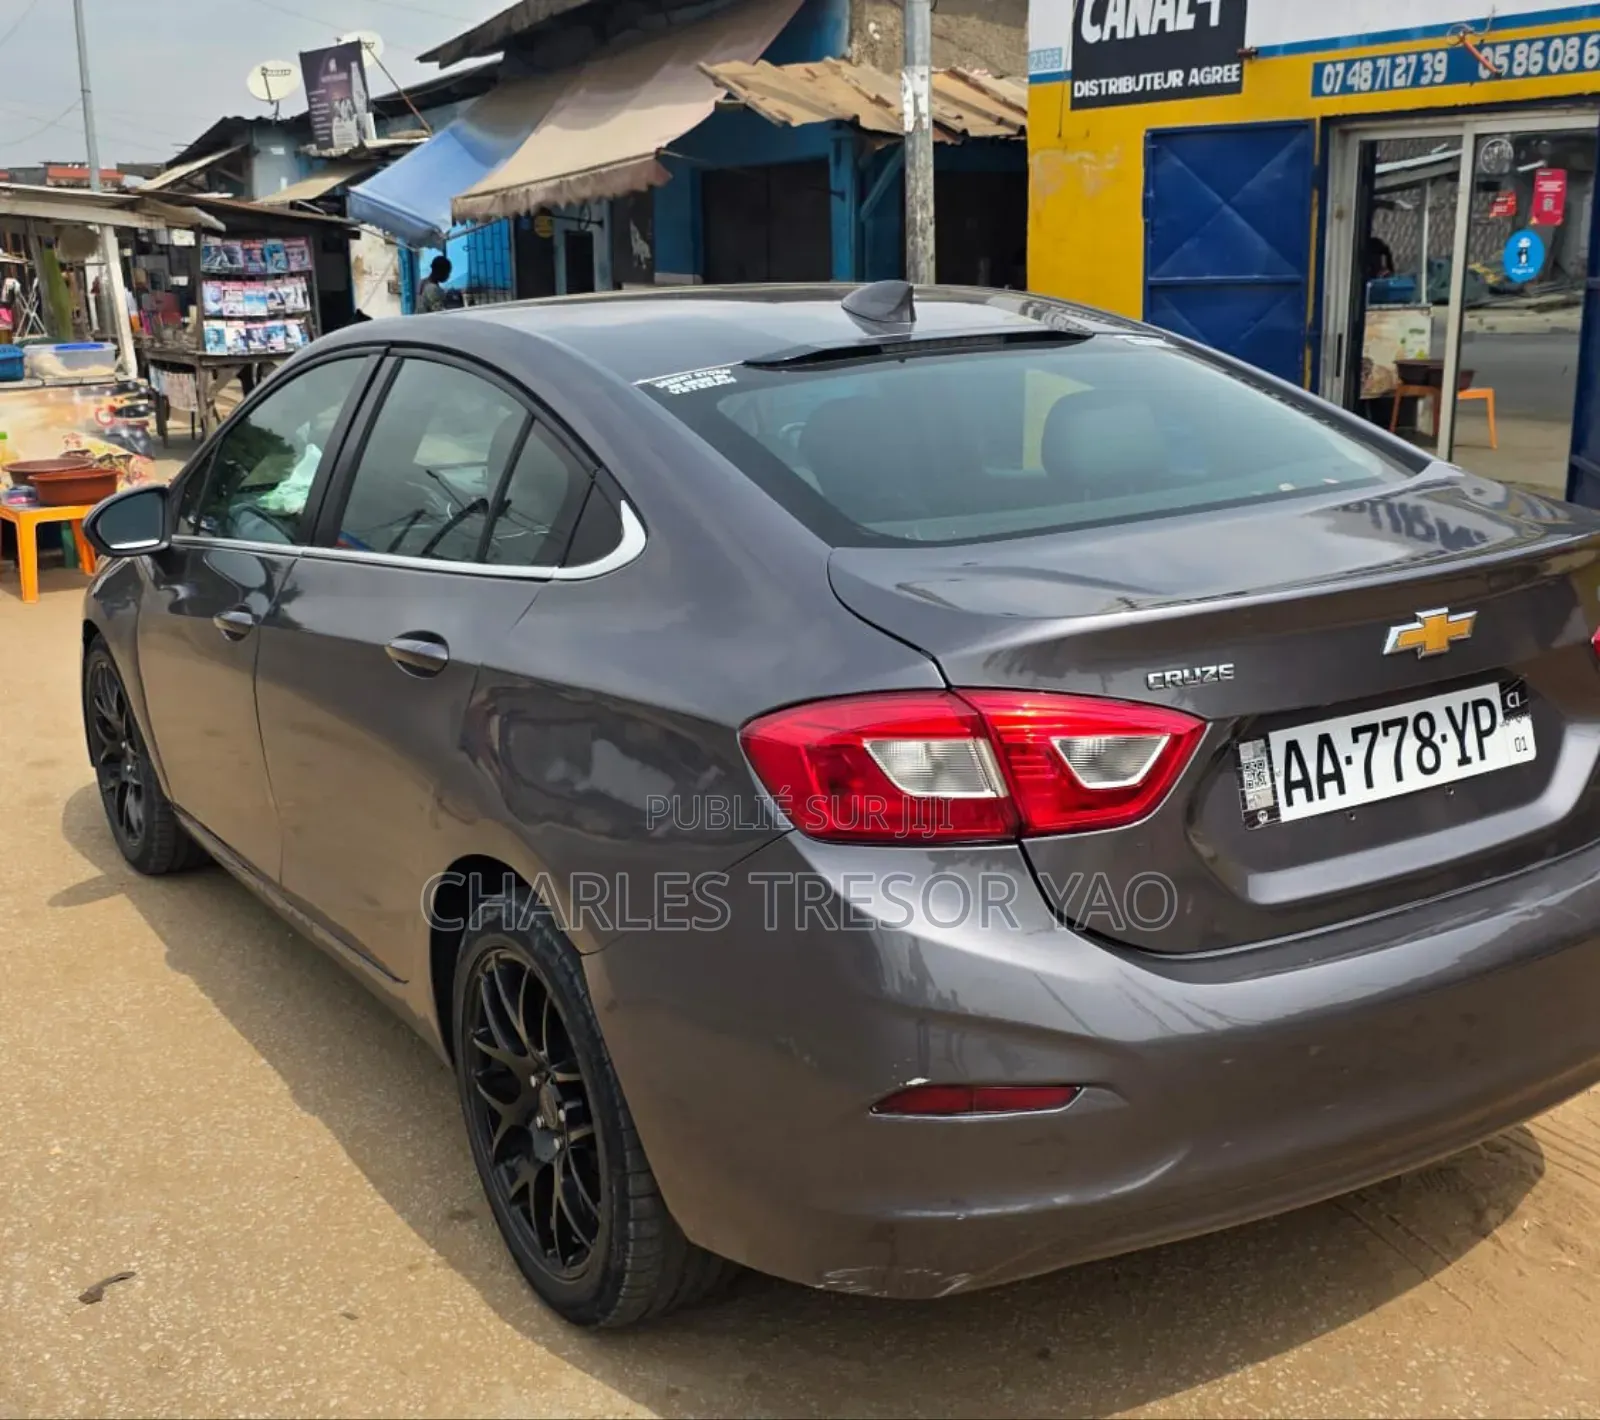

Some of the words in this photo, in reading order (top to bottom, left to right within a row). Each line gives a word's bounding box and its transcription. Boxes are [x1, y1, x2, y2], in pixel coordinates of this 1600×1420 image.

[1073, 68, 1184, 98] DISTRIBUTEUR
[1188, 63, 1241, 85] AGREE
[1322, 63, 1344, 93] 07
[1346, 60, 1372, 92] 48
[1375, 57, 1390, 90] 71
[1392, 52, 1417, 88] 27
[1420, 51, 1447, 85] 39
[1478, 46, 1509, 79] 05
[1512, 40, 1543, 76] 86
[1547, 37, 1579, 73] 08
[1146, 663, 1235, 691] CRUZE
[1514, 736, 1528, 752] 01
